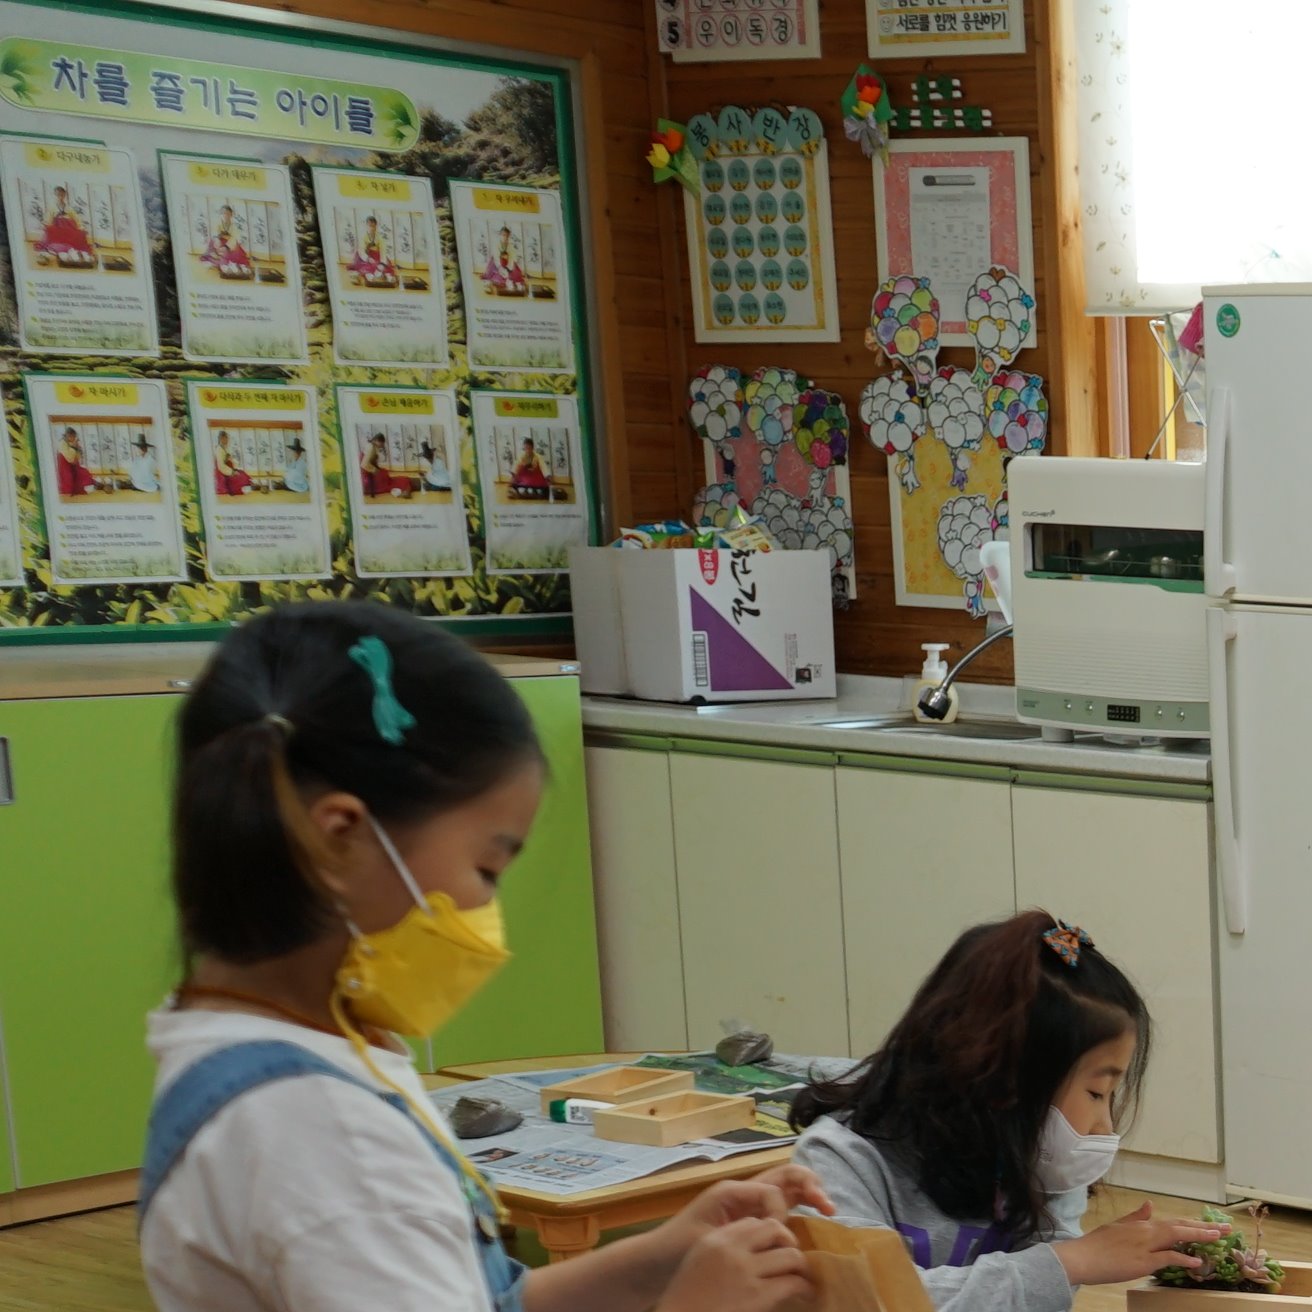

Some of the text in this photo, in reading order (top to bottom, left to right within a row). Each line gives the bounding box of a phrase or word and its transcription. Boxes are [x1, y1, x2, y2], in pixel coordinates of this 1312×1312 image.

[667, 15, 788, 44] 5 우이독경
[897, 12, 1007, 32] 서로를 힘껏 응원하기
[50, 56, 375, 137] 차를 즐기는 아이들
[690, 111, 812, 148] 봉사반장
